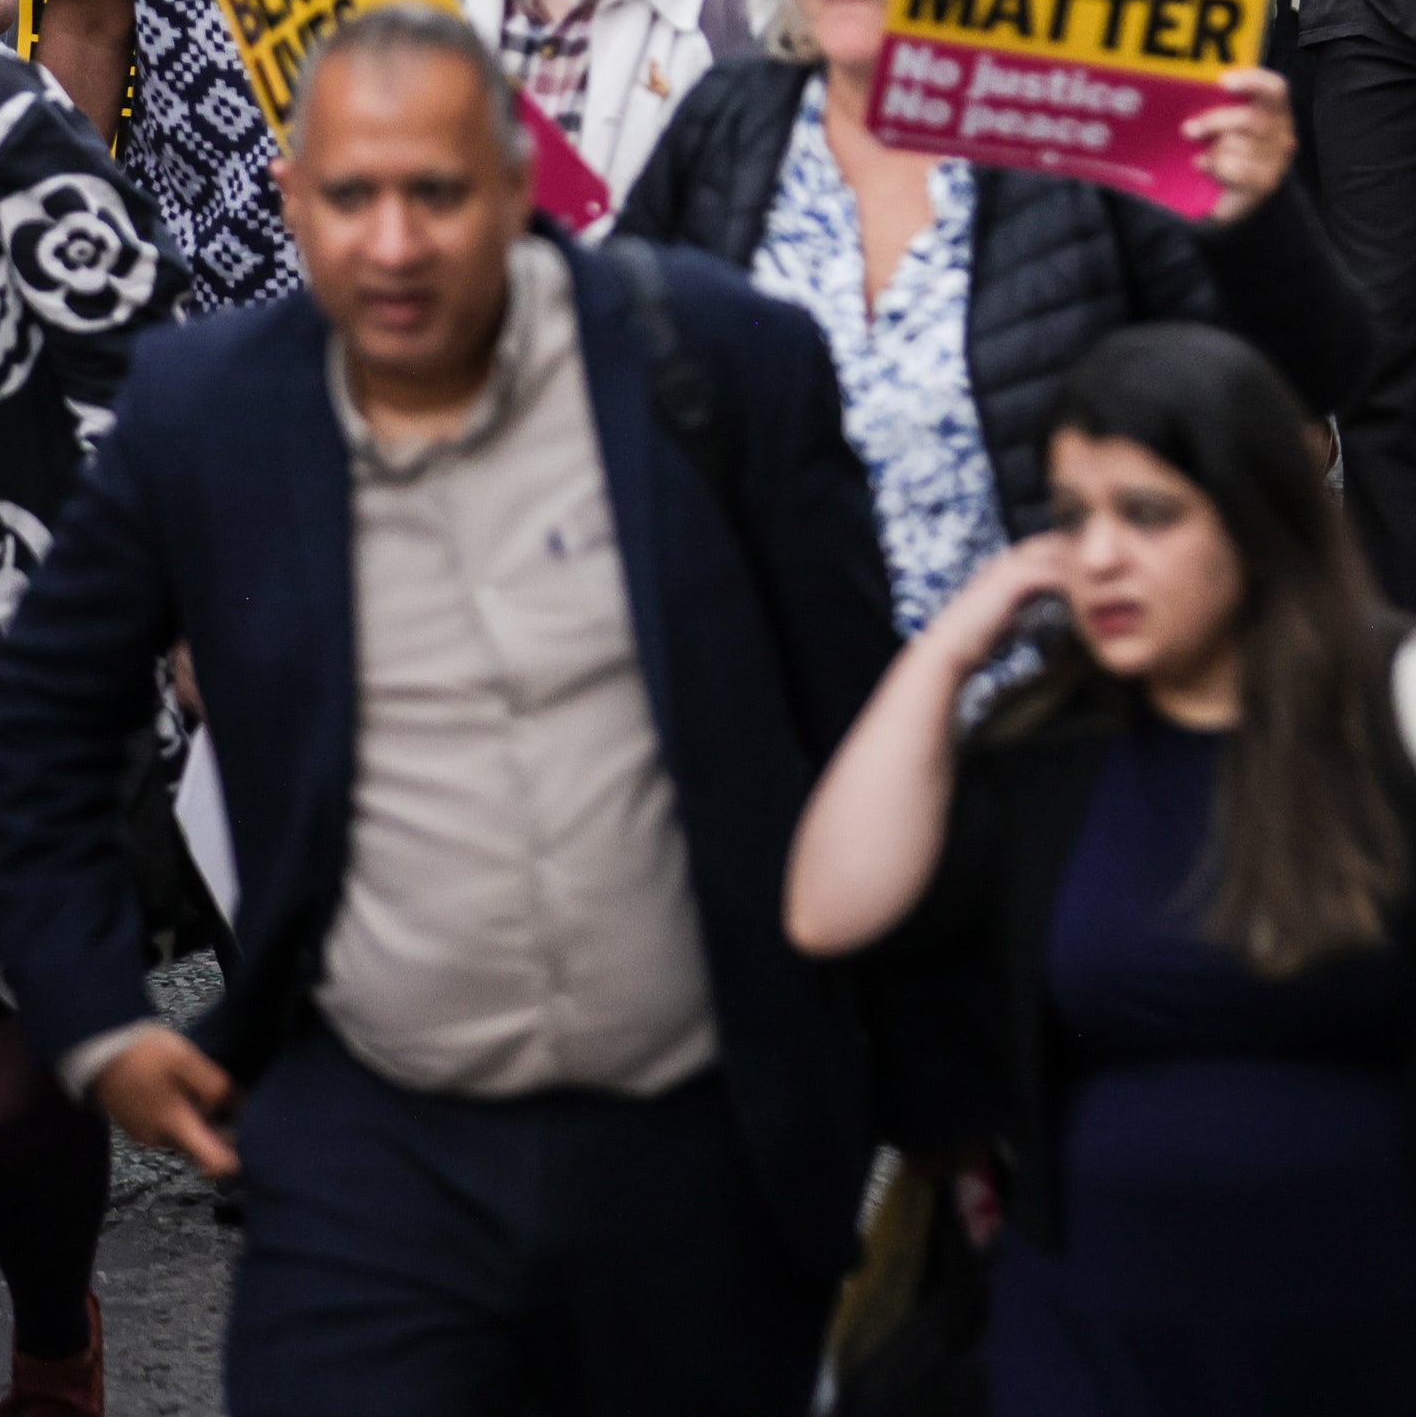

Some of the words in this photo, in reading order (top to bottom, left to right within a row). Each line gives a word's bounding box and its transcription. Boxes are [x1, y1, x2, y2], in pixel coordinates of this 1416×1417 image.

[891, 42, 962, 85] No
[967, 55, 1144, 116] justice
[884, 87, 953, 128] No
[957, 101, 1112, 151] peace
